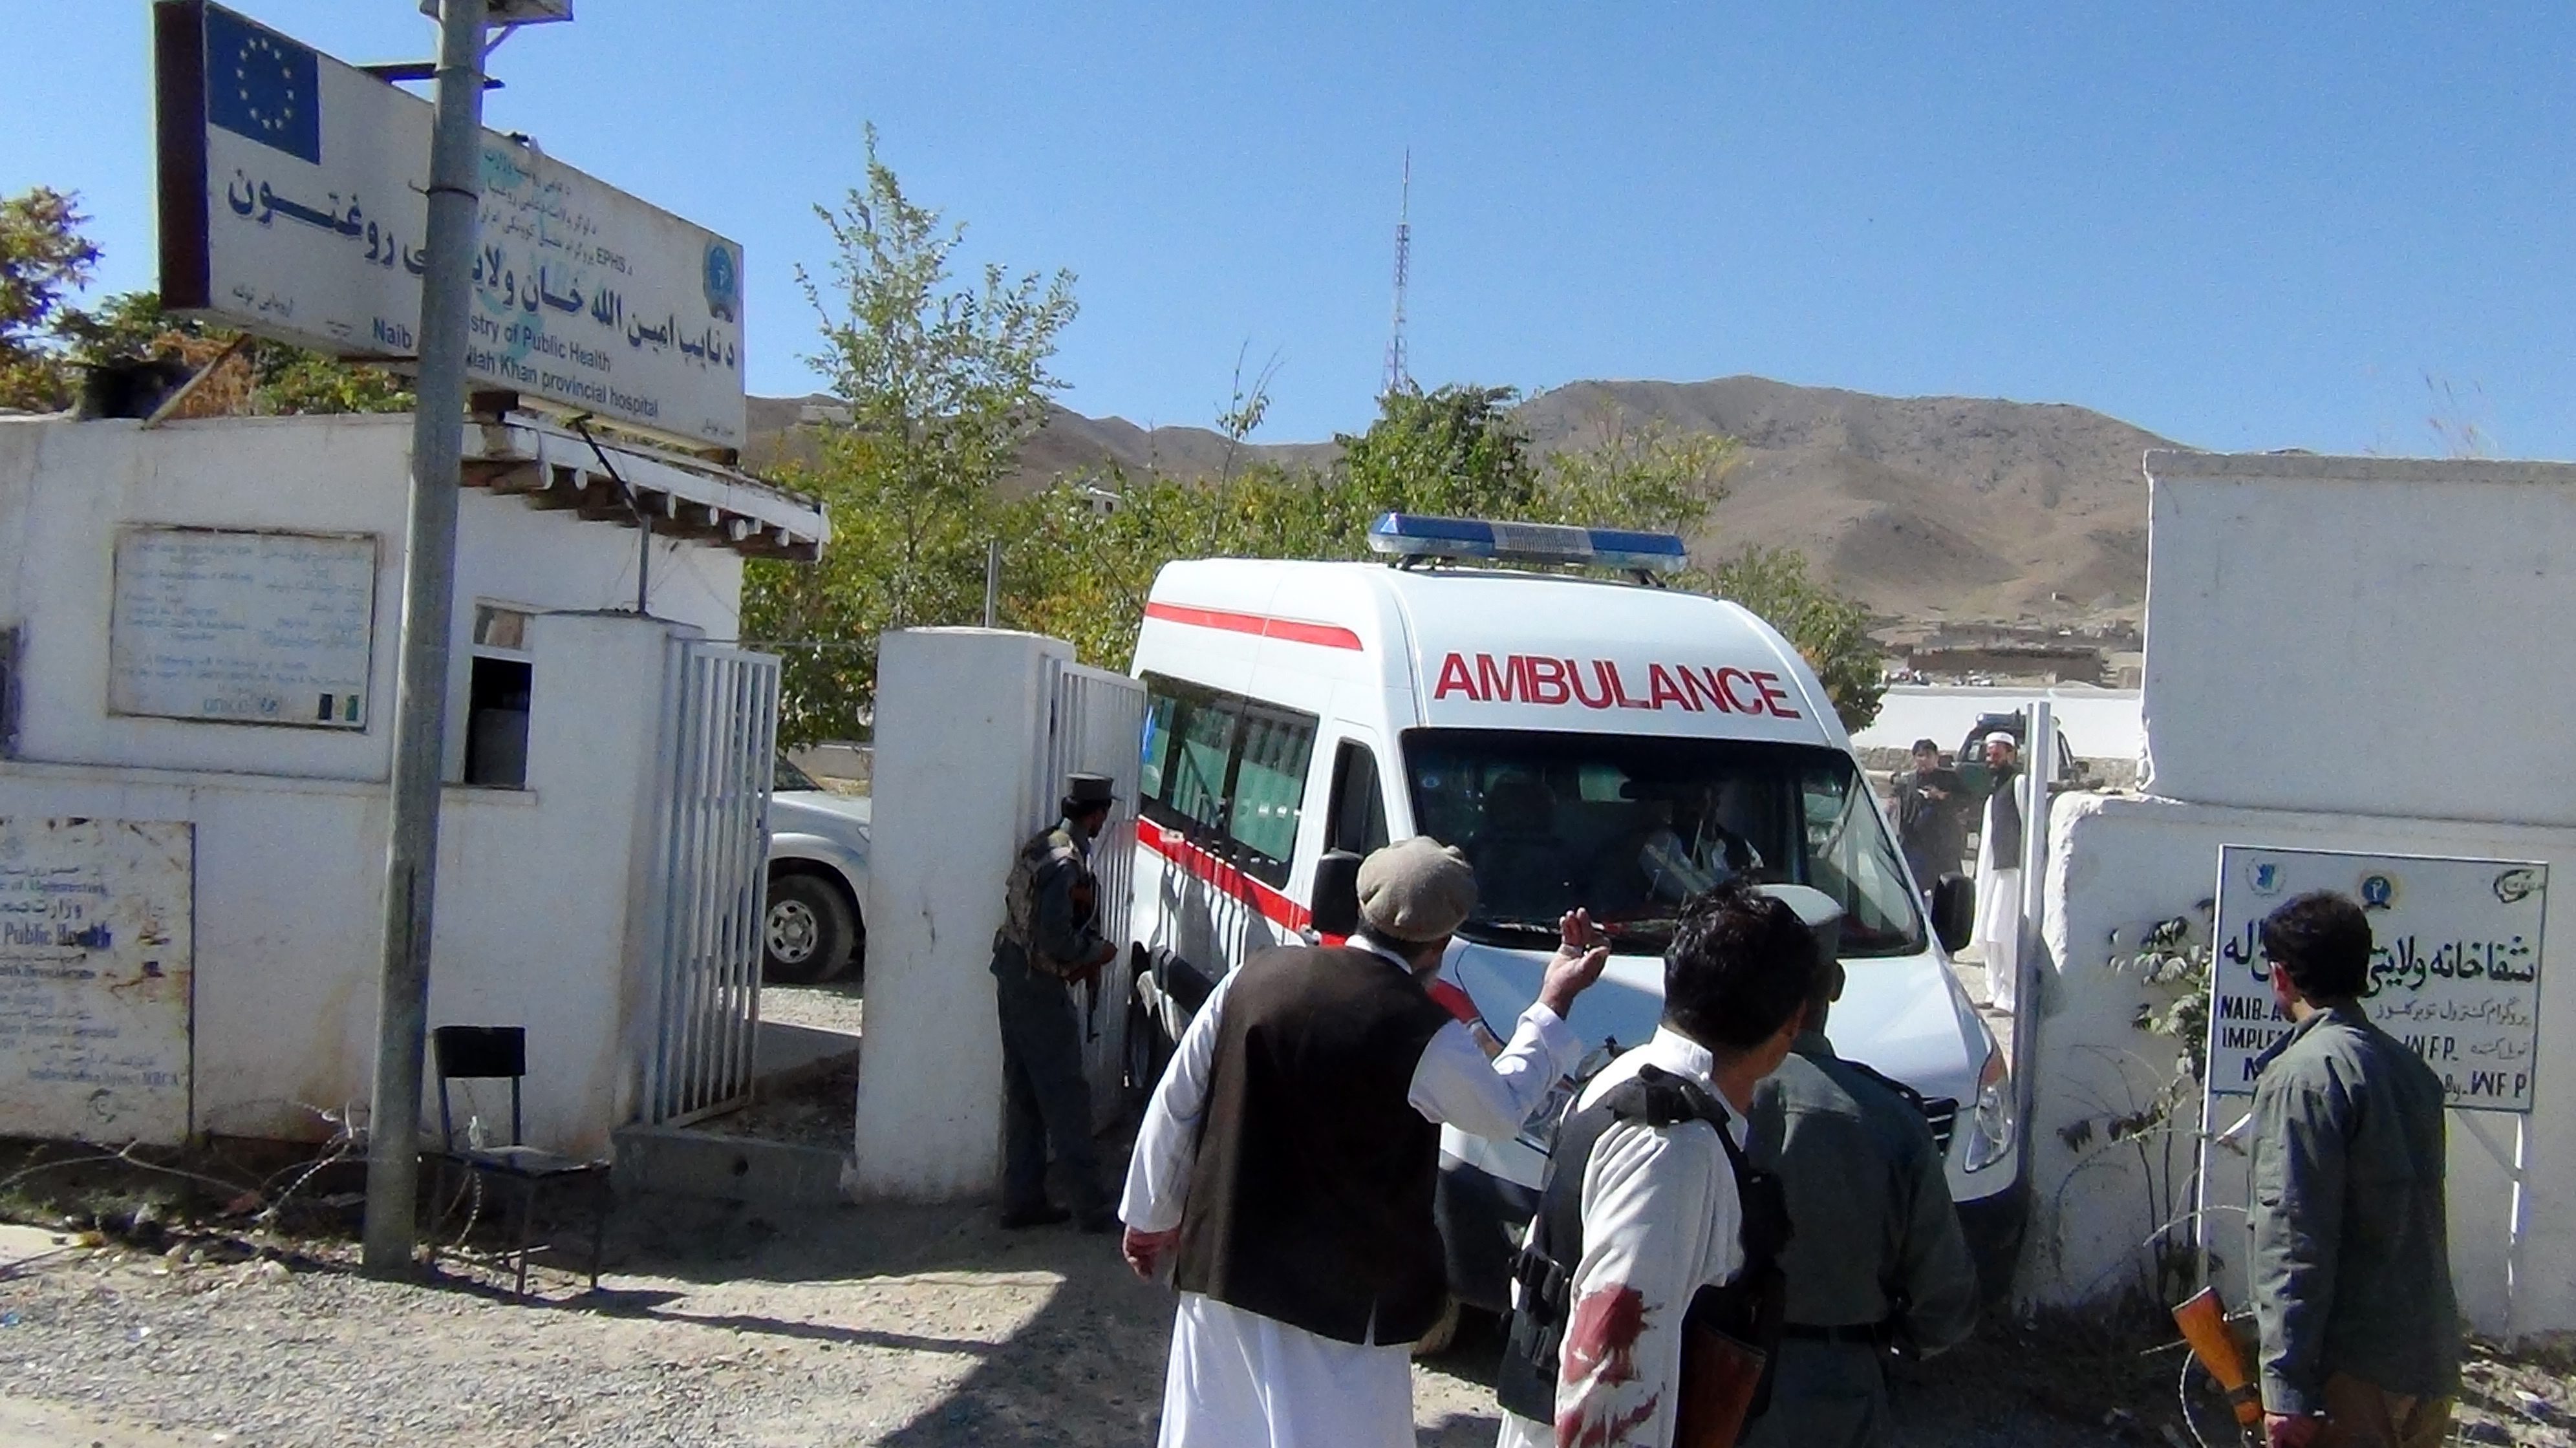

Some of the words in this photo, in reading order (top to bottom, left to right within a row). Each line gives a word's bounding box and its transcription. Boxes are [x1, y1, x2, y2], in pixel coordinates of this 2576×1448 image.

[372, 317, 413, 349] Naib
[499, 354, 538, 384] Khan
[542, 372, 606, 403] provincial
[609, 389, 658, 418] hospital
[470, 314, 500, 344] stry
[504, 323, 520, 343] of
[522, 325, 565, 359] Public
[570, 341, 611, 373] Health
[1434, 652, 1803, 719] AMBULANCE
[5, 921, 52, 946] Public
[2430, 935, 2535, 983] شفاخانه
[2219, 995, 2282, 1022] NAIB-A
[2222, 1027, 2283, 1050] IMPLE
